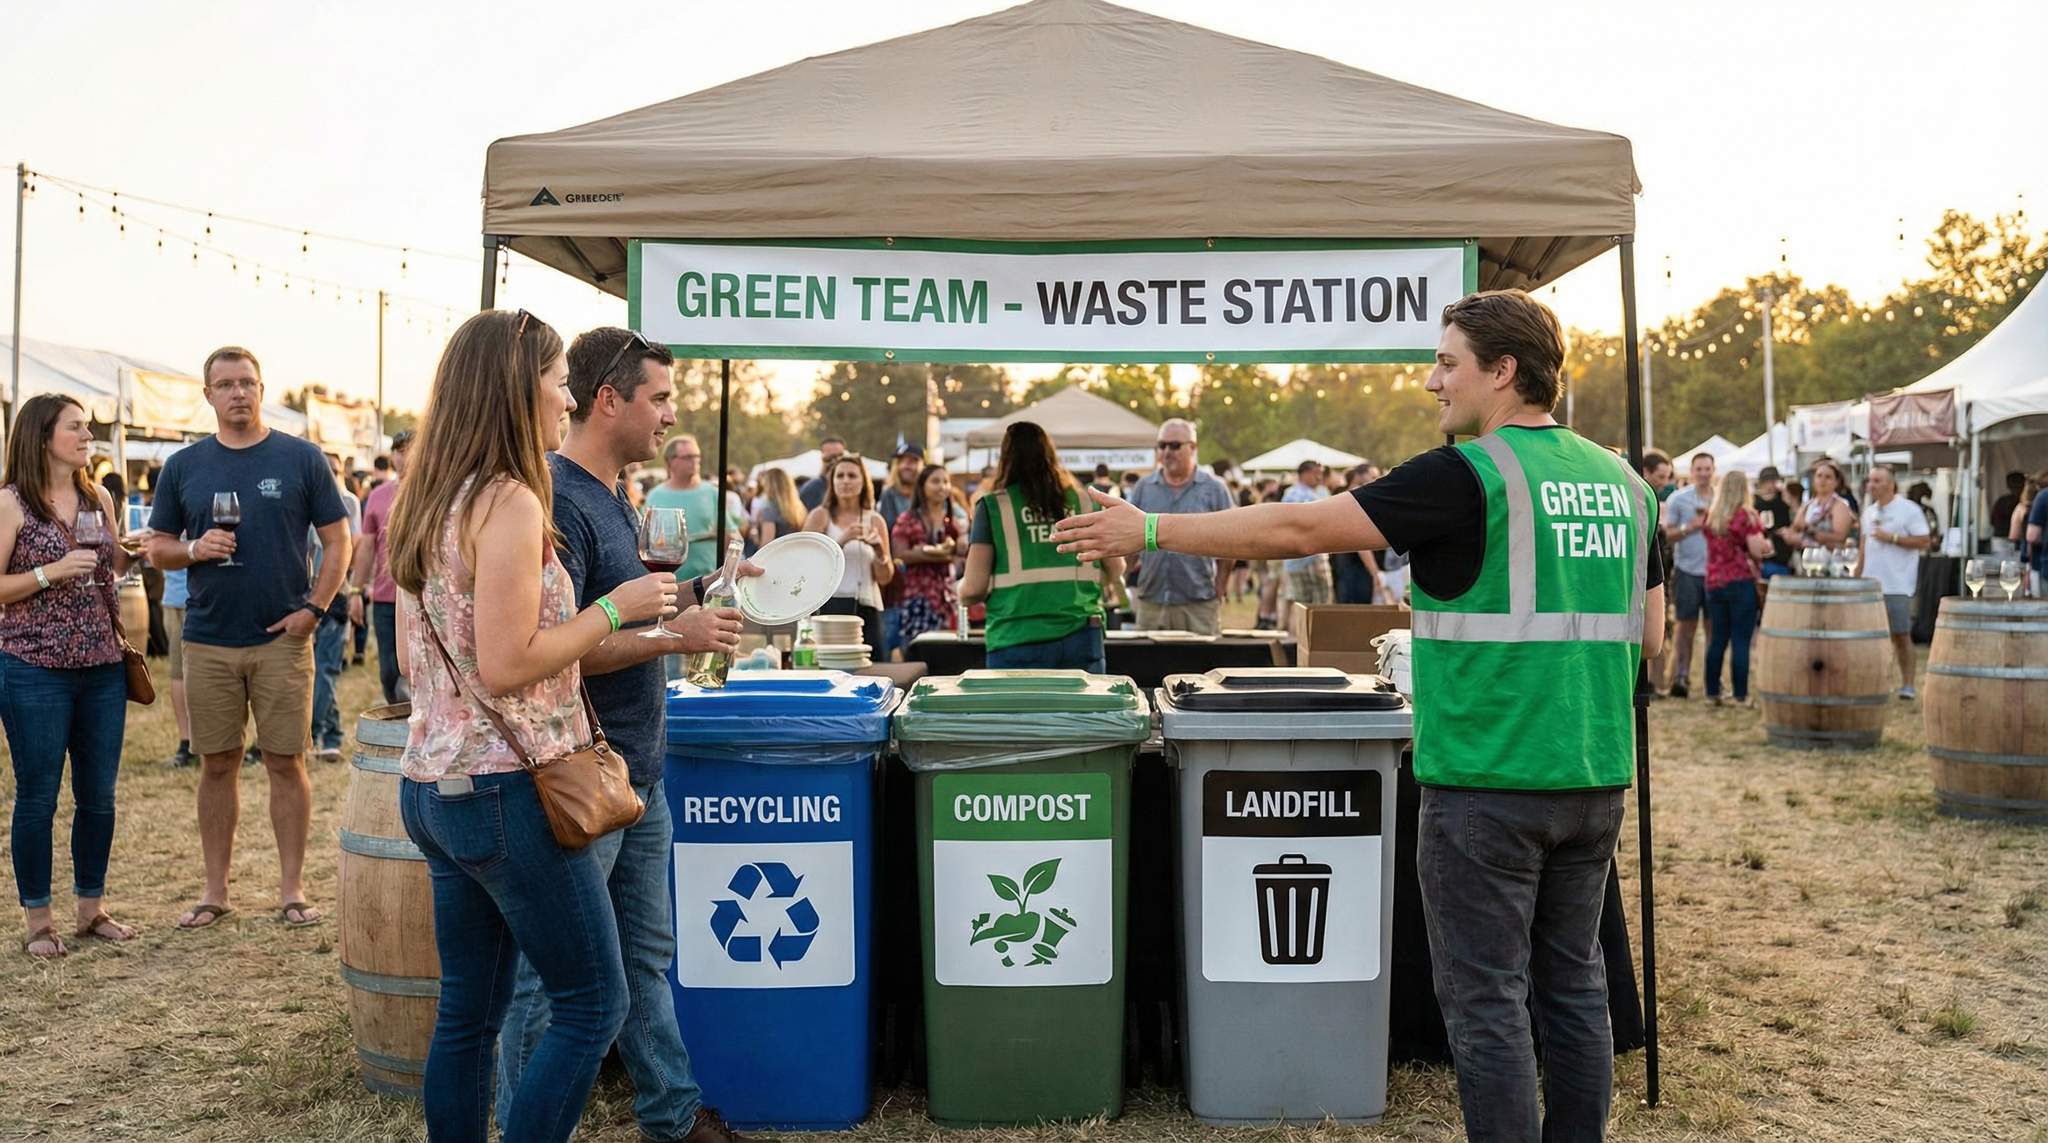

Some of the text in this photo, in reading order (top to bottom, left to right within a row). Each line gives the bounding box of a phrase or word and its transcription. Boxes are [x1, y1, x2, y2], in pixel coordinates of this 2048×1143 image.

[677, 271, 1428, 326] GREEN TEAM - WASTE STATION
[1540, 480, 1631, 518] GREEN
[1551, 522, 1627, 559] TEAM
[684, 795, 841, 824] RECYCLING
[954, 793, 1092, 822] COMPOST
[1226, 790, 1360, 818] LANDFILL
